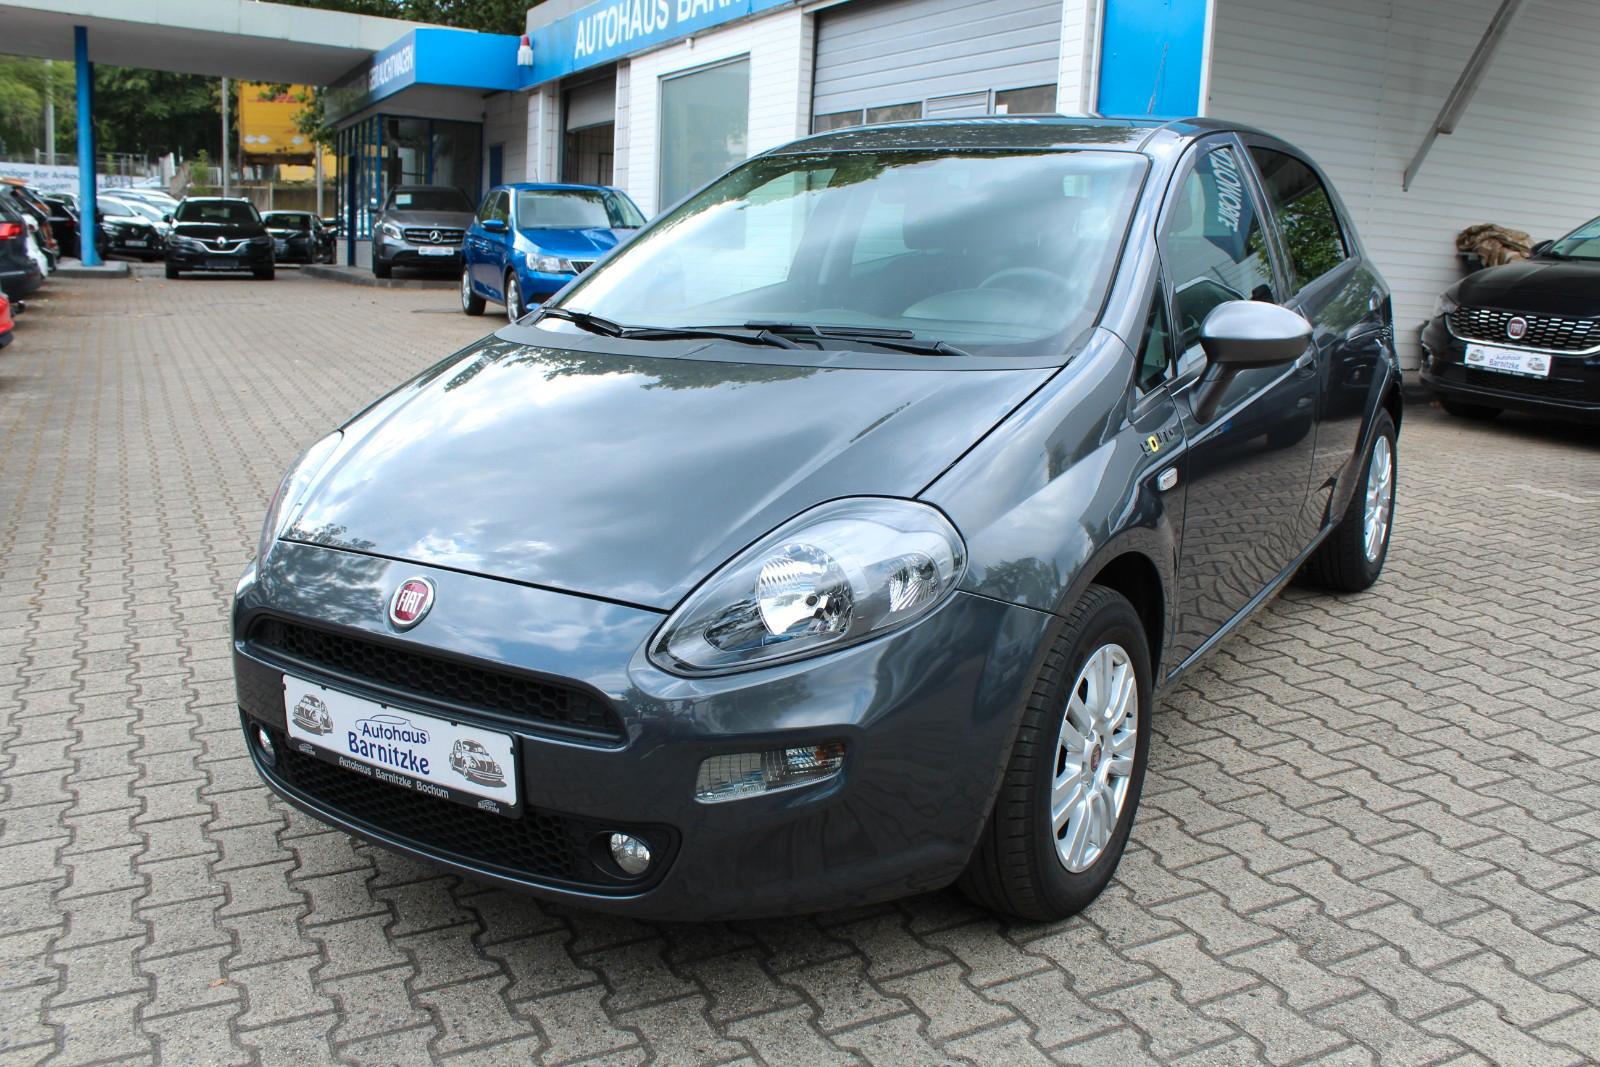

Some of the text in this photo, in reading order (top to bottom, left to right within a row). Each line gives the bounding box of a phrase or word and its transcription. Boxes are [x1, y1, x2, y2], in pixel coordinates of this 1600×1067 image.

[574, 0, 740, 59] AUTOHAUS BA
[397, 589, 424, 614] FIAT
[348, 731, 430, 775] Barnitzke
[362, 722, 427, 744] Autohaus
[339, 756, 449, 799] Autohaus Barnitzke Bochum
